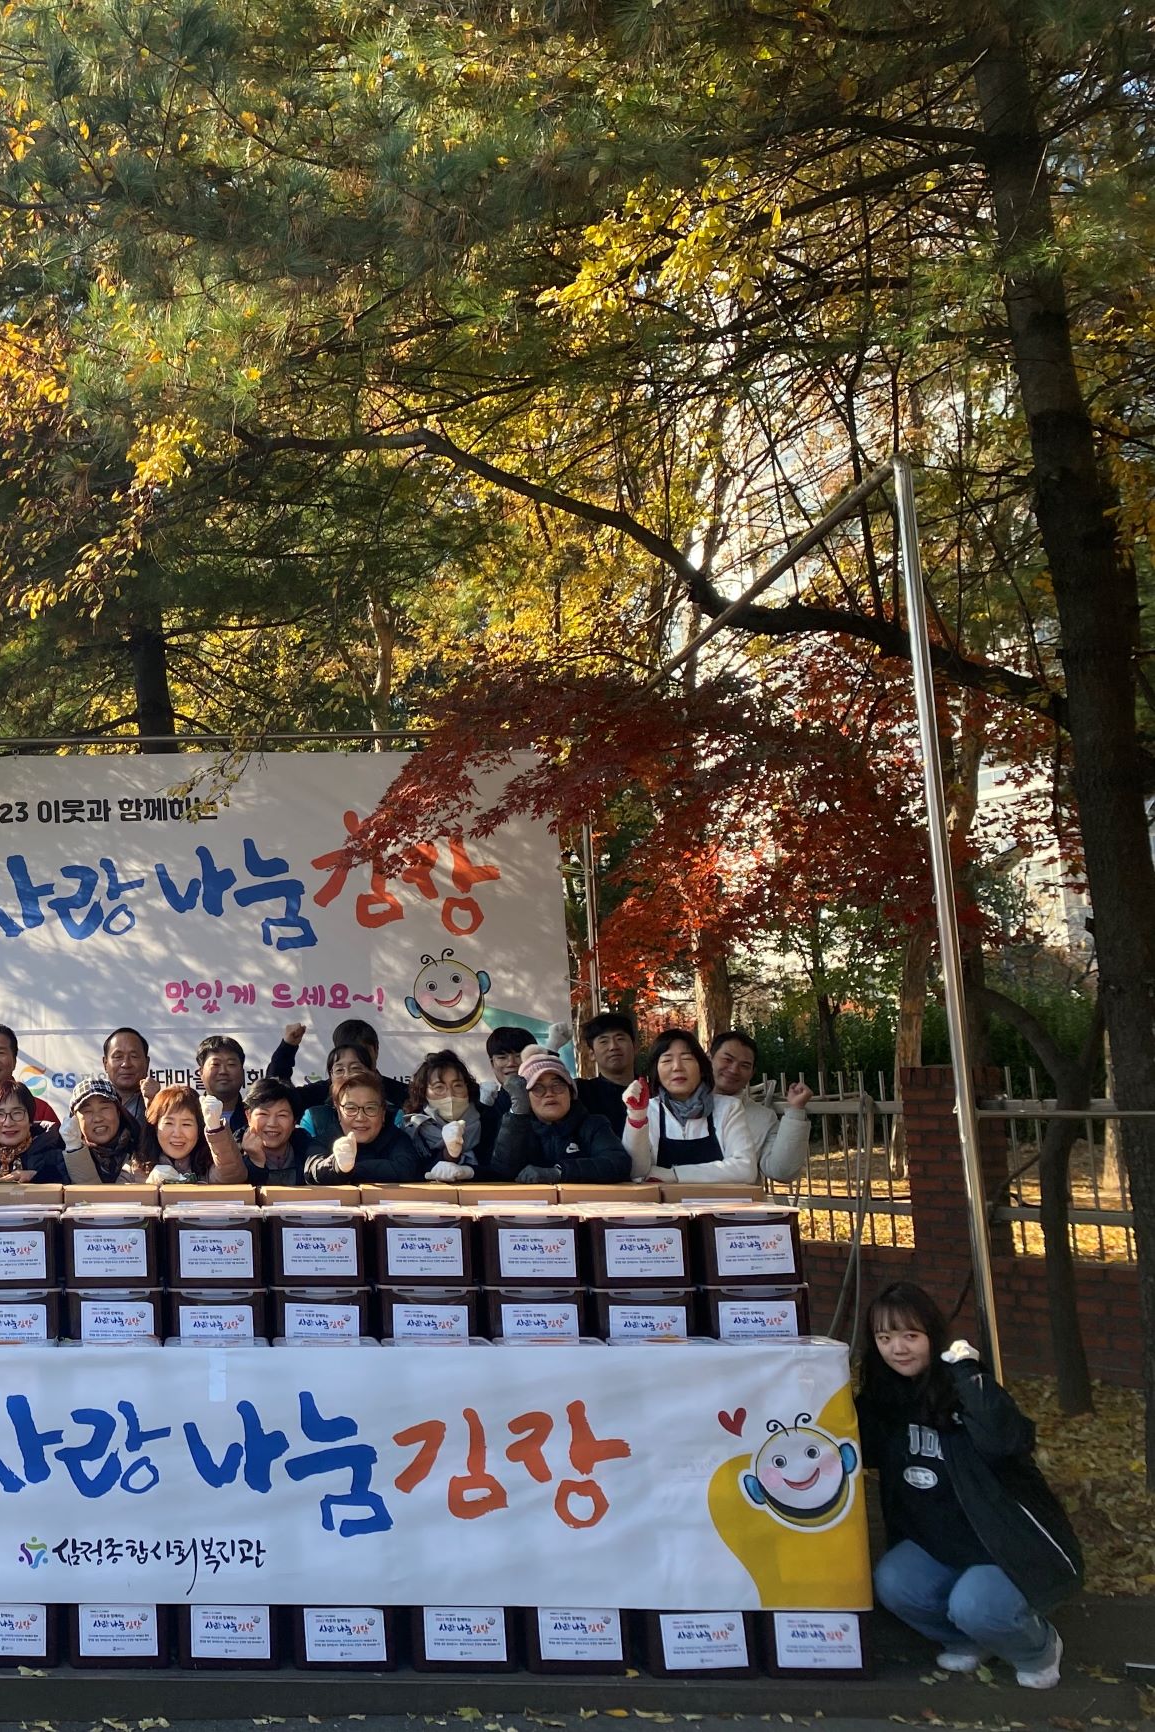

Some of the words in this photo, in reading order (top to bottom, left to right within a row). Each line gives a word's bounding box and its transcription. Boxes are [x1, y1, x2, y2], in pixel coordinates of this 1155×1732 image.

[37, 799, 112, 824] 이웃과
[165, 980, 256, 1013] 맛있게
[51, 1072, 76, 1088] GS
[52, 1536, 266, 1596] 삼정종합사회복지관
